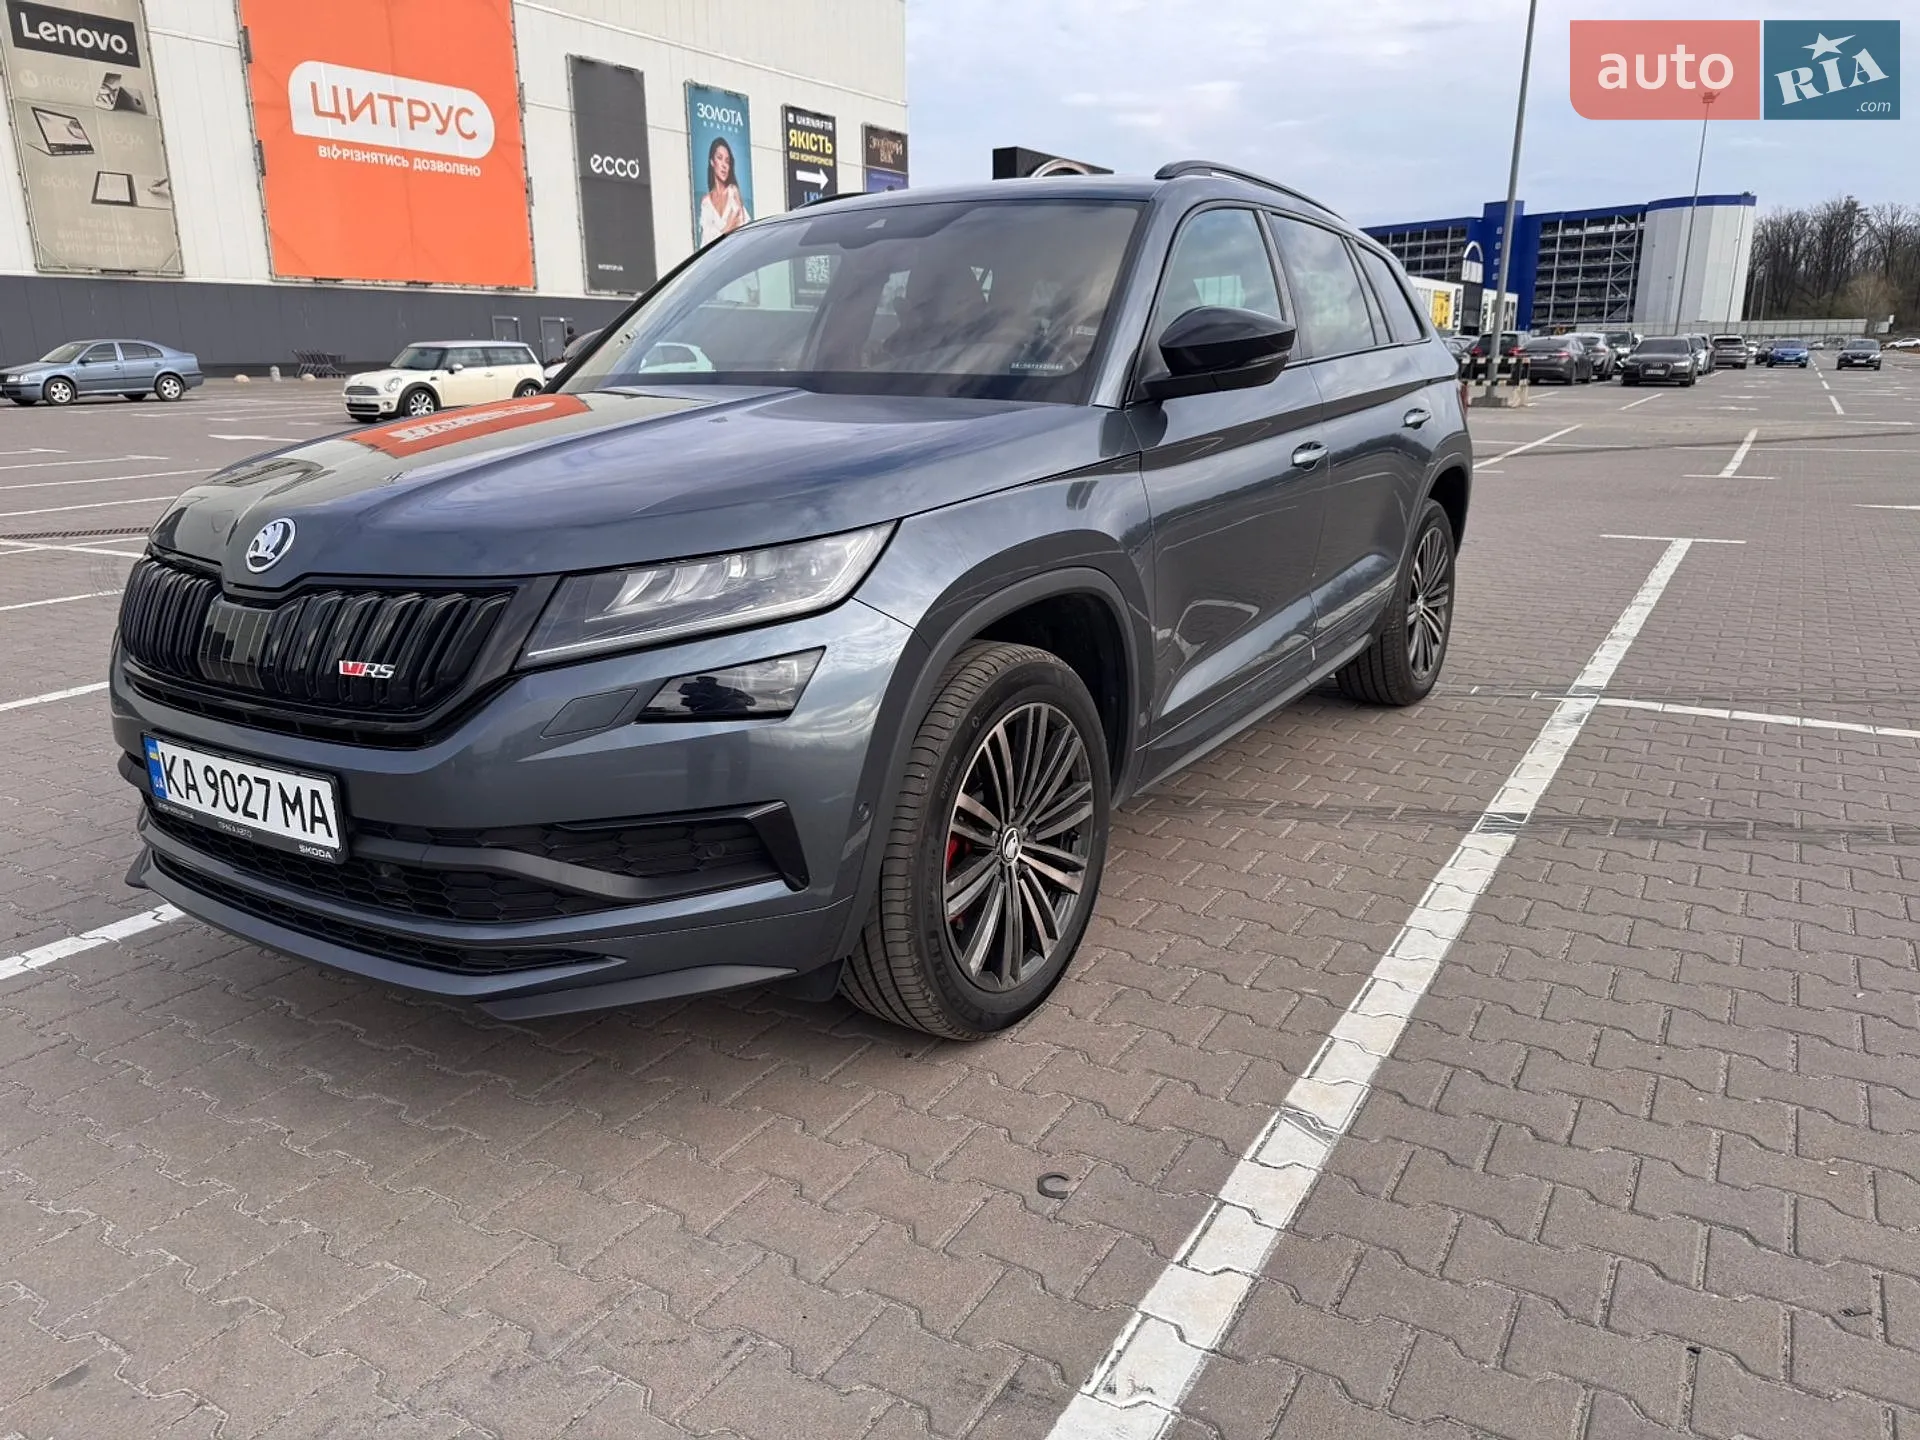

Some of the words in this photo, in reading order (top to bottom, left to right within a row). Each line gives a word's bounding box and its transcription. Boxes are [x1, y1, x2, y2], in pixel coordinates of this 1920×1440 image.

[20, 12, 129, 54] Lenovo
[310, 81, 478, 140] ЦИТРУС
[697, 102, 744, 127] ЗОЛОТА
[789, 129, 833, 154] ЯКІСТЬ
[413, 158, 482, 177] ДОЗВОЛЕНО
[590, 154, 640, 179] ecco
[161, 751, 203, 804] KA
[203, 765, 271, 823] 9027
[279, 781, 334, 839] MA
